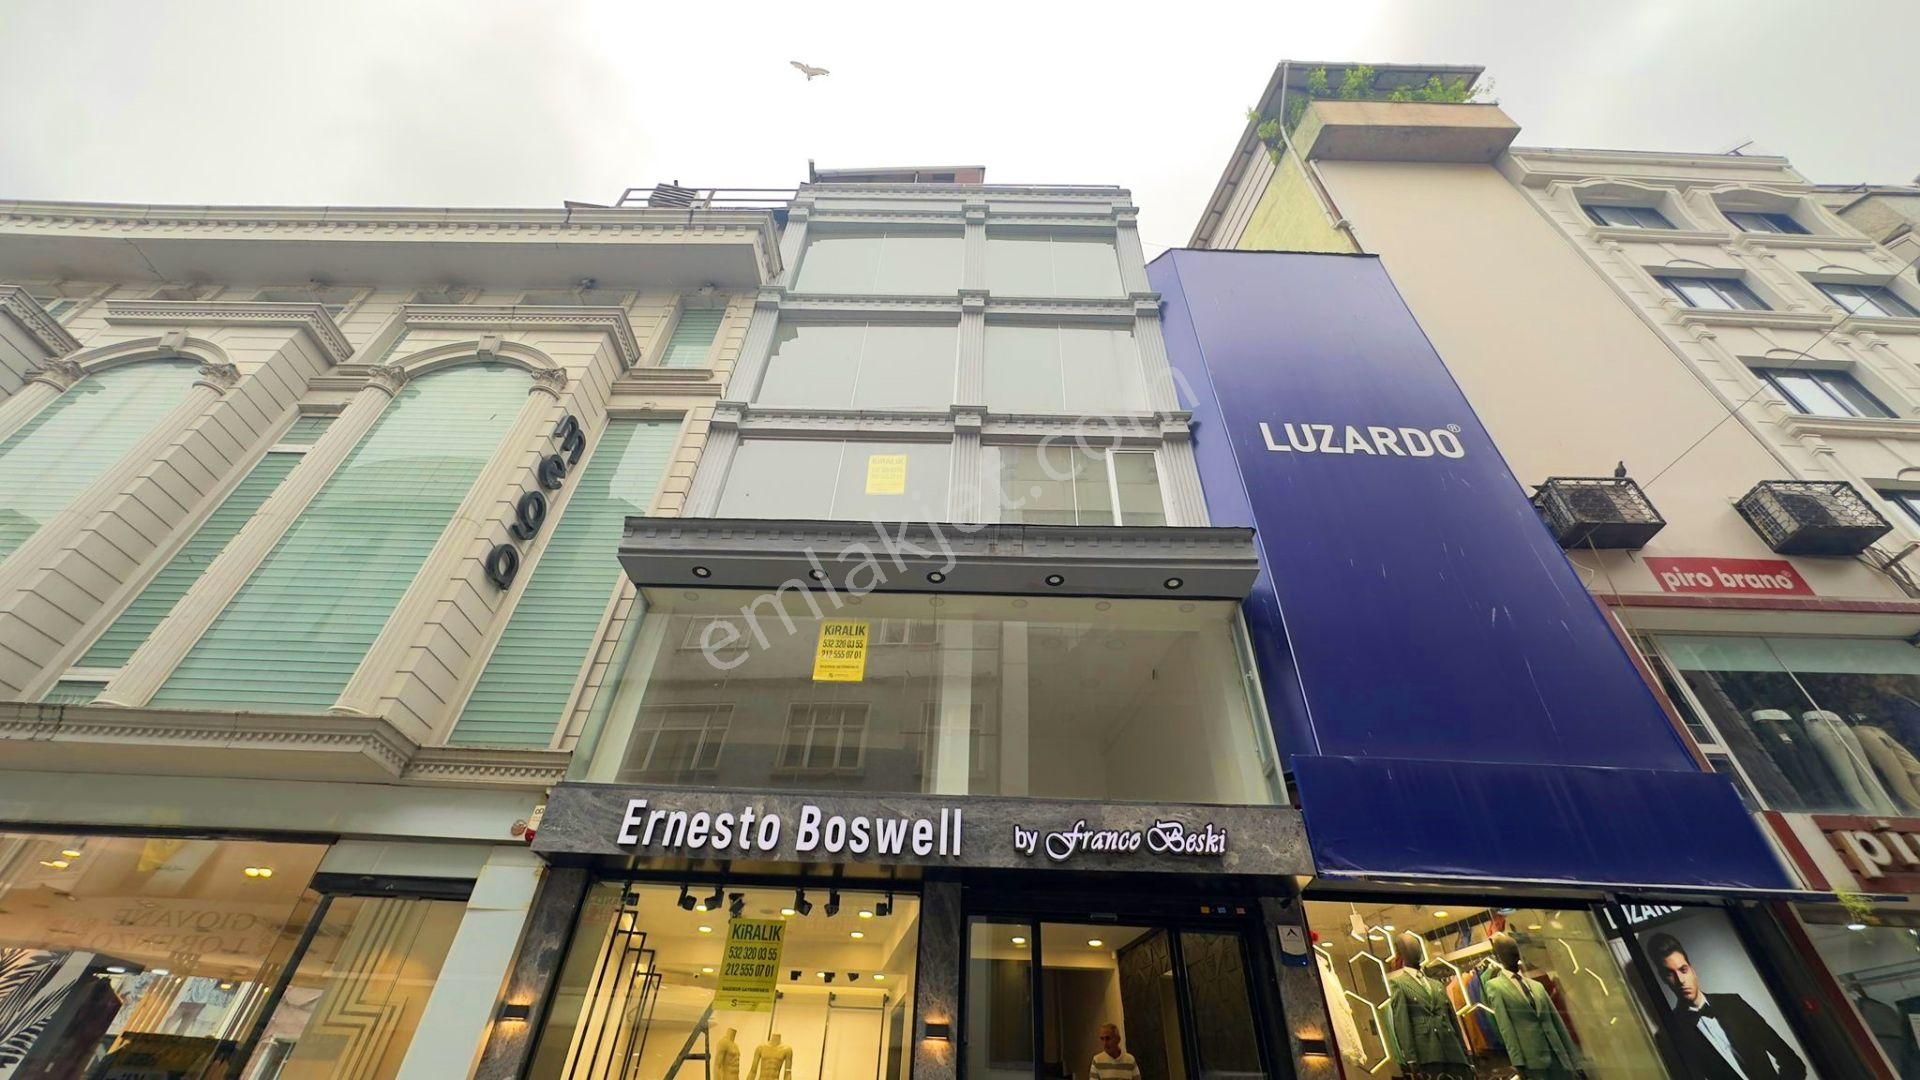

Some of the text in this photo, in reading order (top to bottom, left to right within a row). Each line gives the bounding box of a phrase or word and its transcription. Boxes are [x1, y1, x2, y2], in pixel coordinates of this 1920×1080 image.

[1660, 566, 1714, 592] piro
[822, 639, 835, 648] 532
[834, 639, 847, 649] 320
[855, 639, 864, 649] 55
[833, 650, 846, 659] 555
[853, 650, 862, 660] 01
[616, 799, 963, 857] Ernesto Boswell
[1014, 819, 1227, 861] by Franco Beski
[728, 945, 778, 961] 532 320 03 55
[724, 962, 775, 978] 212 555 07 01
